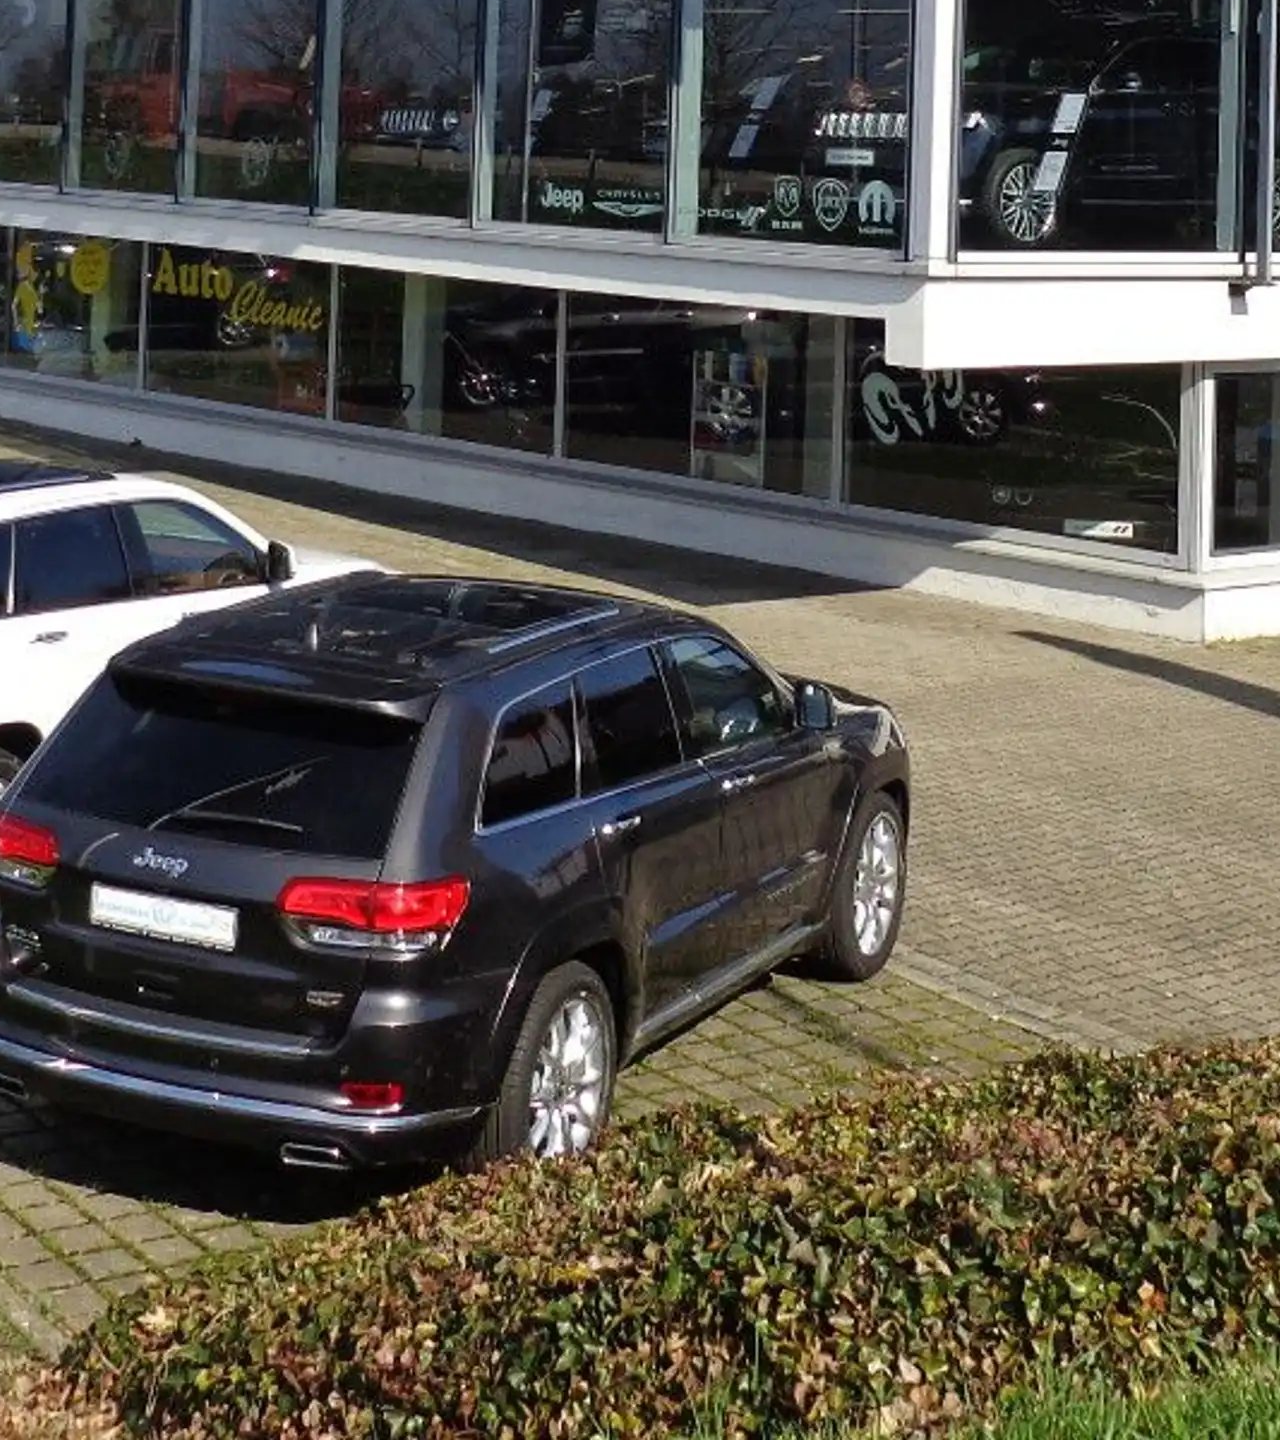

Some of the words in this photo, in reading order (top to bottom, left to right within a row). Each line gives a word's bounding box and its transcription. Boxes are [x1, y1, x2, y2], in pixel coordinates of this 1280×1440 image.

[540, 182, 585, 213] Jeep
[153, 247, 233, 301] Auto
[229, 280, 325, 331] Cleanic
[132, 846, 189, 879] Jeep
